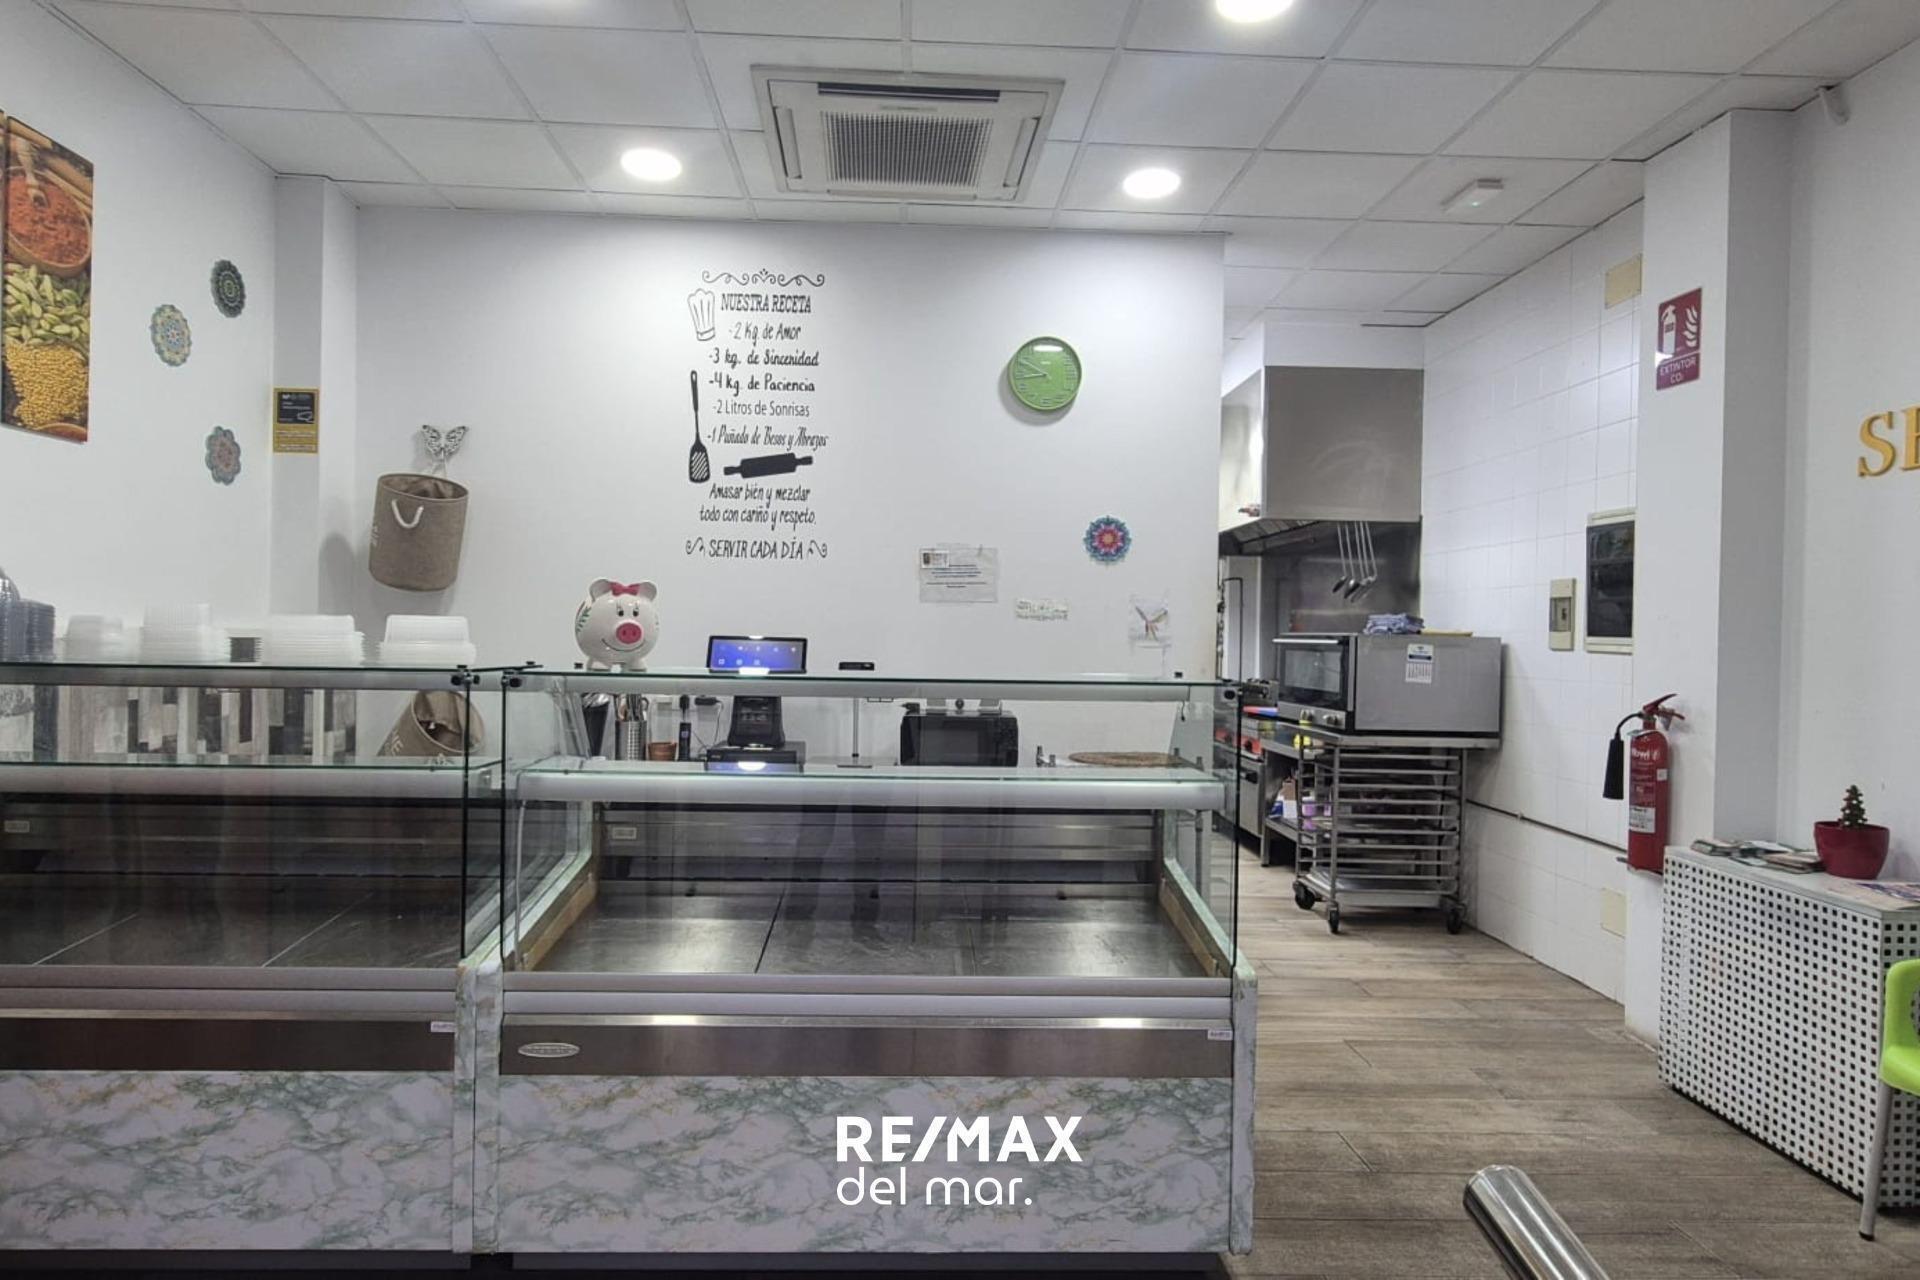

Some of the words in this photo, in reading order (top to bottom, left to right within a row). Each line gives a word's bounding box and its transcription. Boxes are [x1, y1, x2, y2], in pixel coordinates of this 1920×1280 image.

[721, 293, 769, 311] NUESTRA
[771, 294, 812, 313] RECETA
[762, 323, 774, 340] de
[776, 323, 802, 340] Amor
[747, 349, 760, 365] de
[1660, 355, 1697, 377] EXTINTOR
[747, 375, 760, 390] de
[764, 373, 816, 391] Paciencia
[725, 400, 752, 415] Litros
[754, 400, 767, 415] de
[770, 400, 810, 417] Sonrisas
[750, 425, 761, 445] de
[763, 425, 787, 446] Besos
[786, 435, 795, 451] y
[709, 483, 743, 500] Amasar
[765, 487, 773, 509] y
[775, 484, 811, 502] mezclar
[700, 504, 720, 522] todo
[722, 509, 739, 523] con
[740, 505, 769, 522] cariño
[770, 510, 778, 532] y
[709, 538, 748, 558] SERVIR
[750, 540, 777, 559] CADA
[780, 537, 803, 559] DÍA
